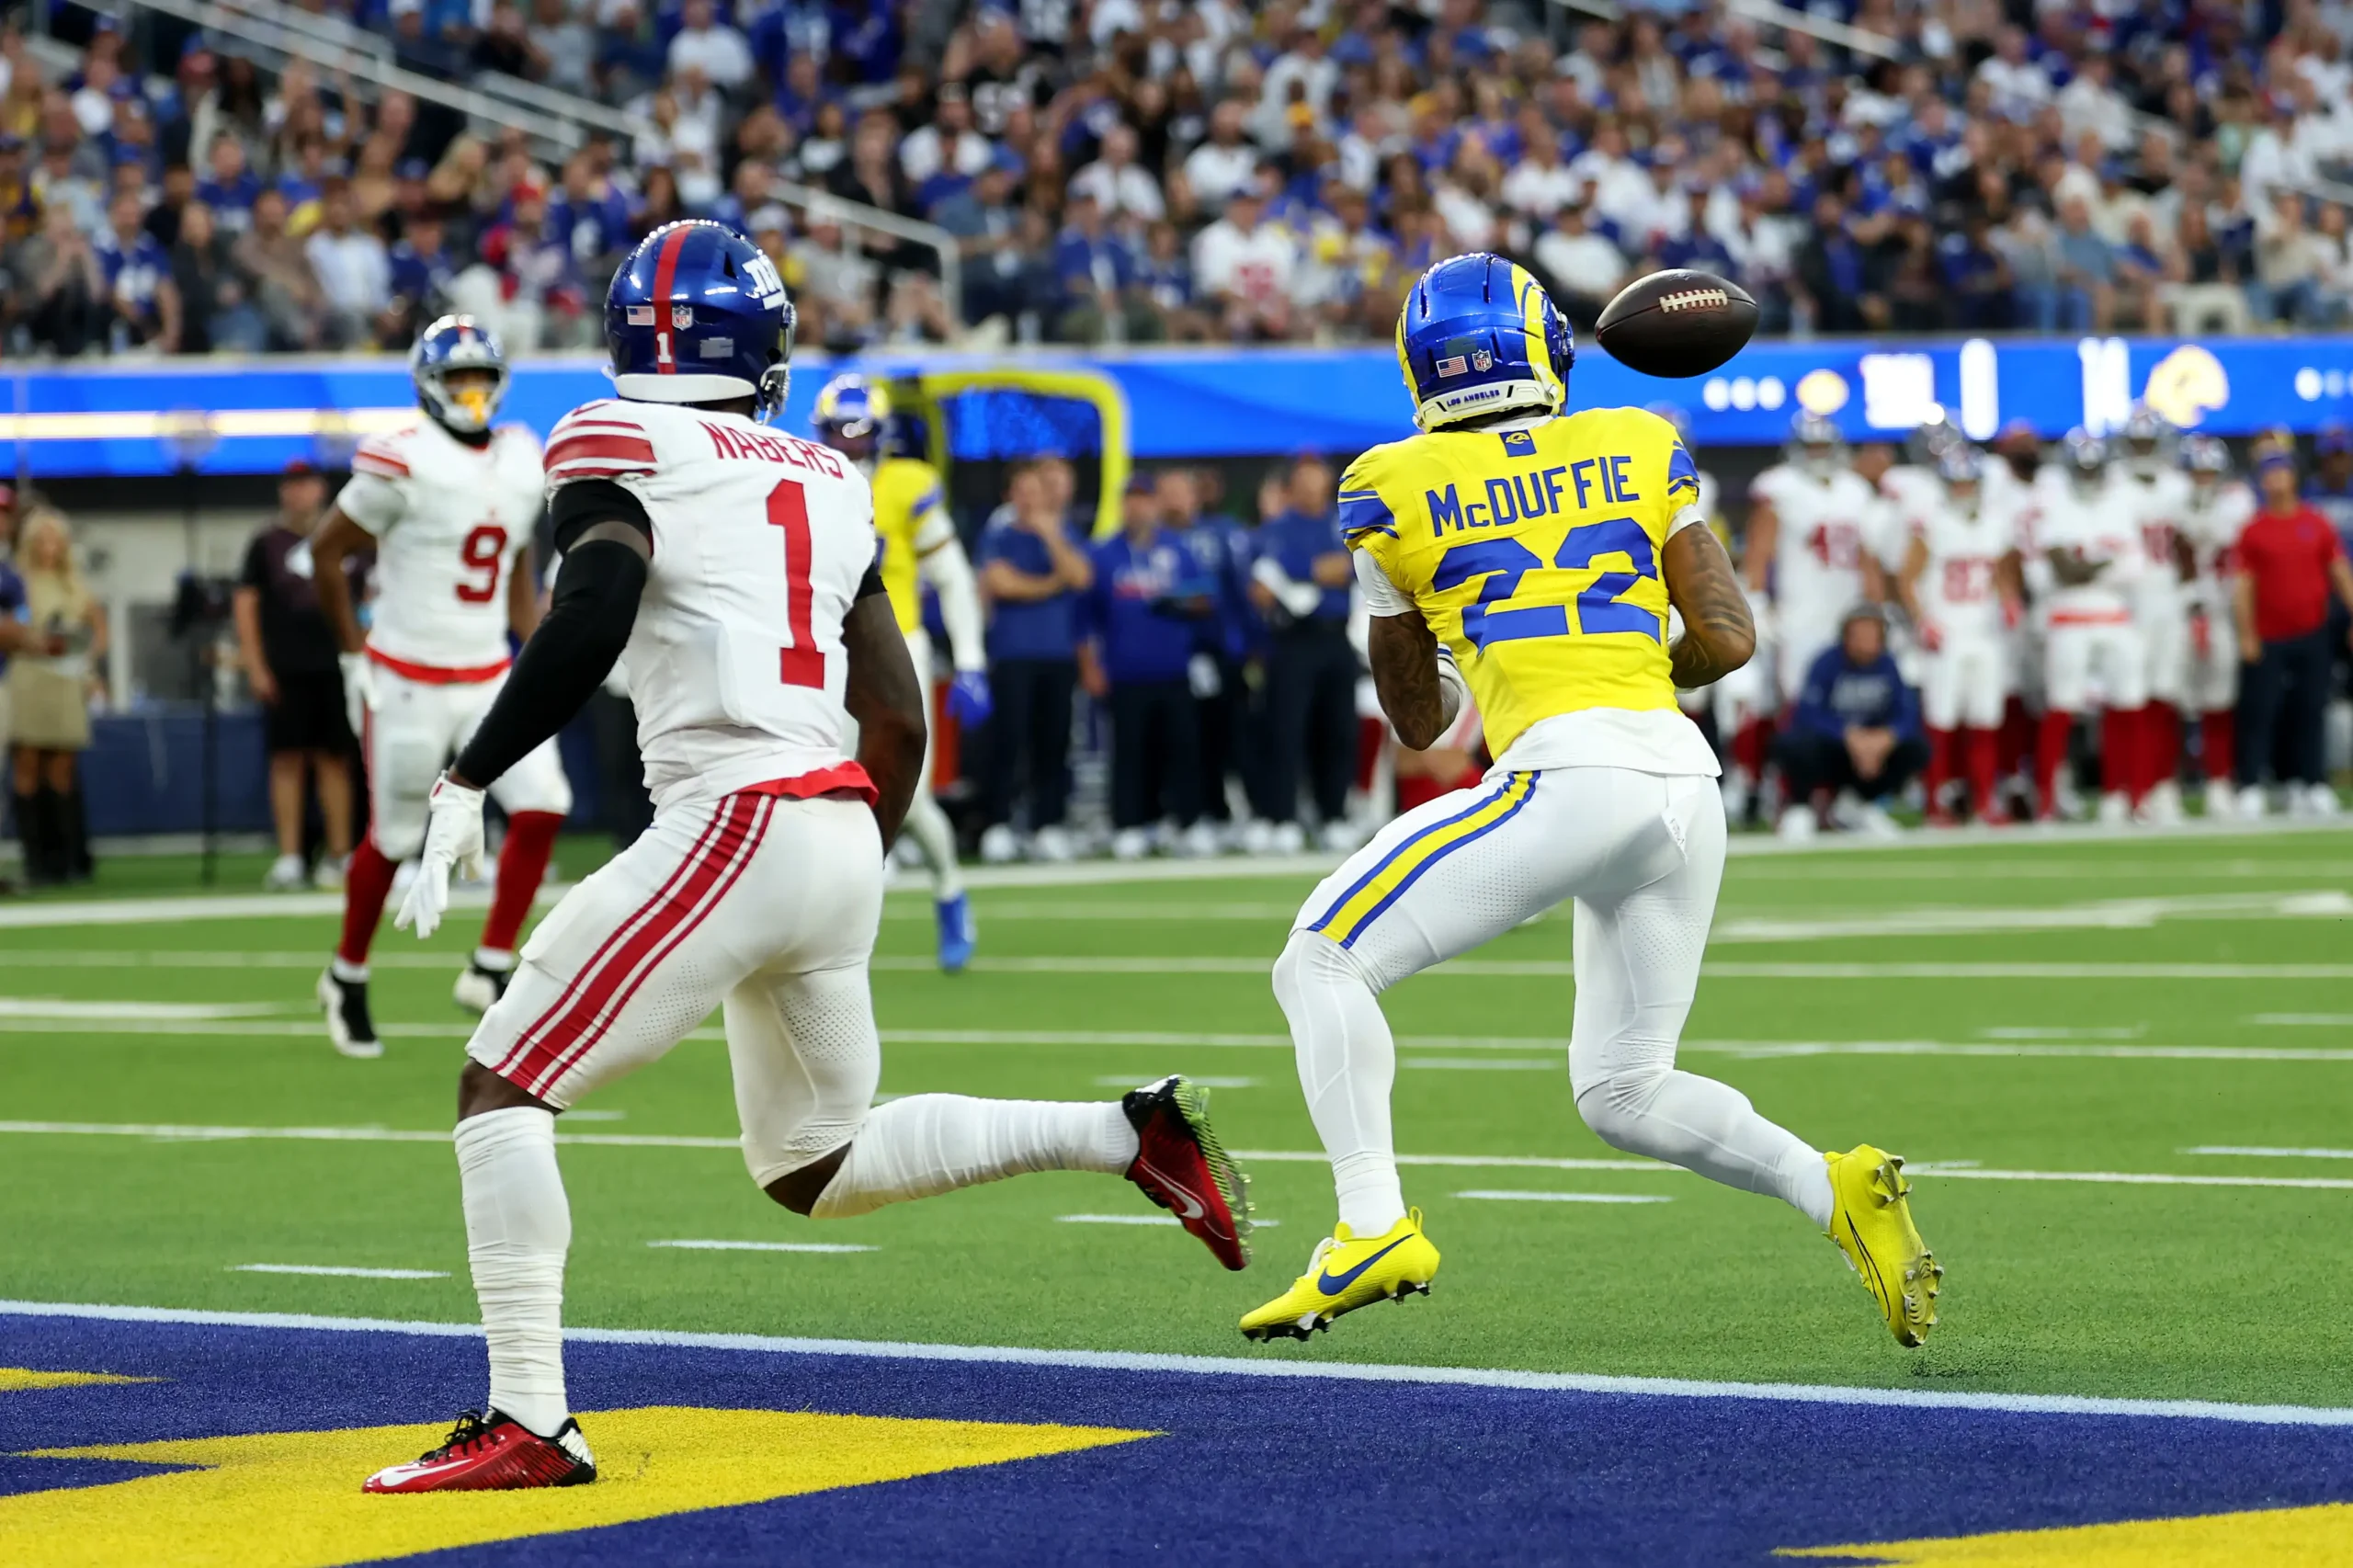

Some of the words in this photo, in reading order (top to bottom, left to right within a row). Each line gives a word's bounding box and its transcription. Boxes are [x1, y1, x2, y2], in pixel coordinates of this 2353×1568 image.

[656, 332, 672, 364] 1
[1447, 397, 1461, 407] LOS
[1463, 389, 1500, 403] ANGELES
[699, 420, 844, 479] NABERS
[1425, 455, 1640, 538] McDUFFIE
[455, 524, 507, 604] 9
[766, 478, 824, 690] 1
[1431, 517, 1661, 657] 22
